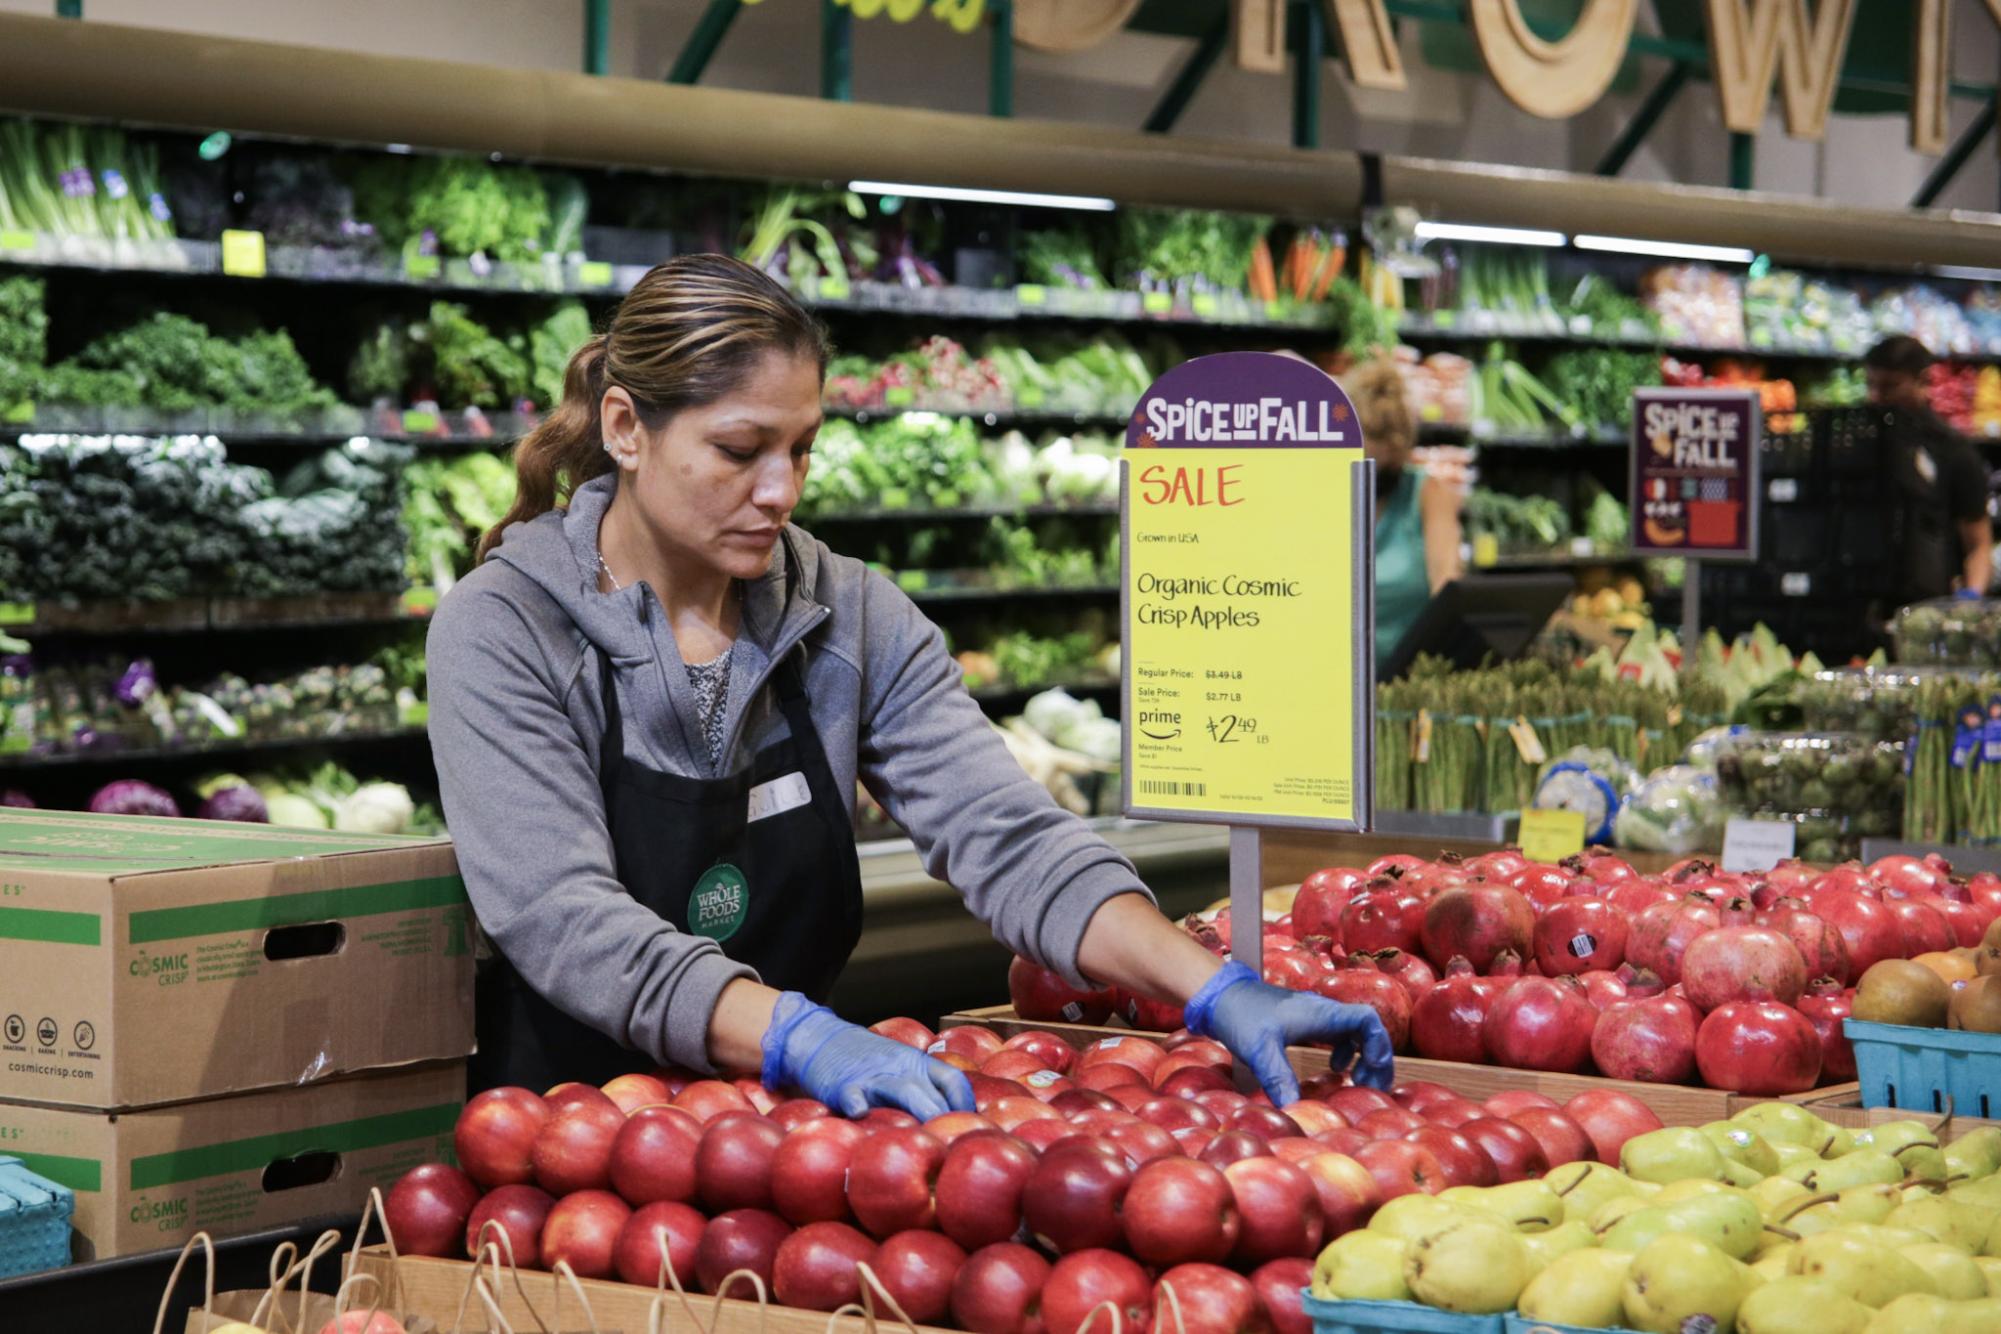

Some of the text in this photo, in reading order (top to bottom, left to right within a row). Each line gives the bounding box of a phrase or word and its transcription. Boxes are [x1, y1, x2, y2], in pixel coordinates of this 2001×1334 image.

[1233, 403, 1259, 430] UP
[1260, 397, 1344, 441] FALL
[1674, 438, 1737, 467] FALL
[1139, 463, 1246, 507] SALE
[1136, 532, 1199, 544] Grown in USA
[1137, 572, 1303, 601] Organic Cosmic
[1137, 603, 1261, 630] Crisp Apples
[1137, 667, 1168, 679] Regular
[1170, 668, 1194, 679] Price:
[1231, 670, 1243, 680] LB
[1138, 687, 1242, 702] Sale Price: $2.77 LB
[1139, 707, 1182, 726] prime
[1138, 743, 1183, 752] Member Price
[1256, 735, 1270, 744] LB
[696, 883, 741, 907] WHOLE
[698, 899, 741, 922] FOODS
[701, 915, 735, 929] MARKET
[129, 951, 189, 977] COSMIC
[8, 1062, 94, 1080] cosmiccrisp.com
[130, 1197, 188, 1223] COSMIC
